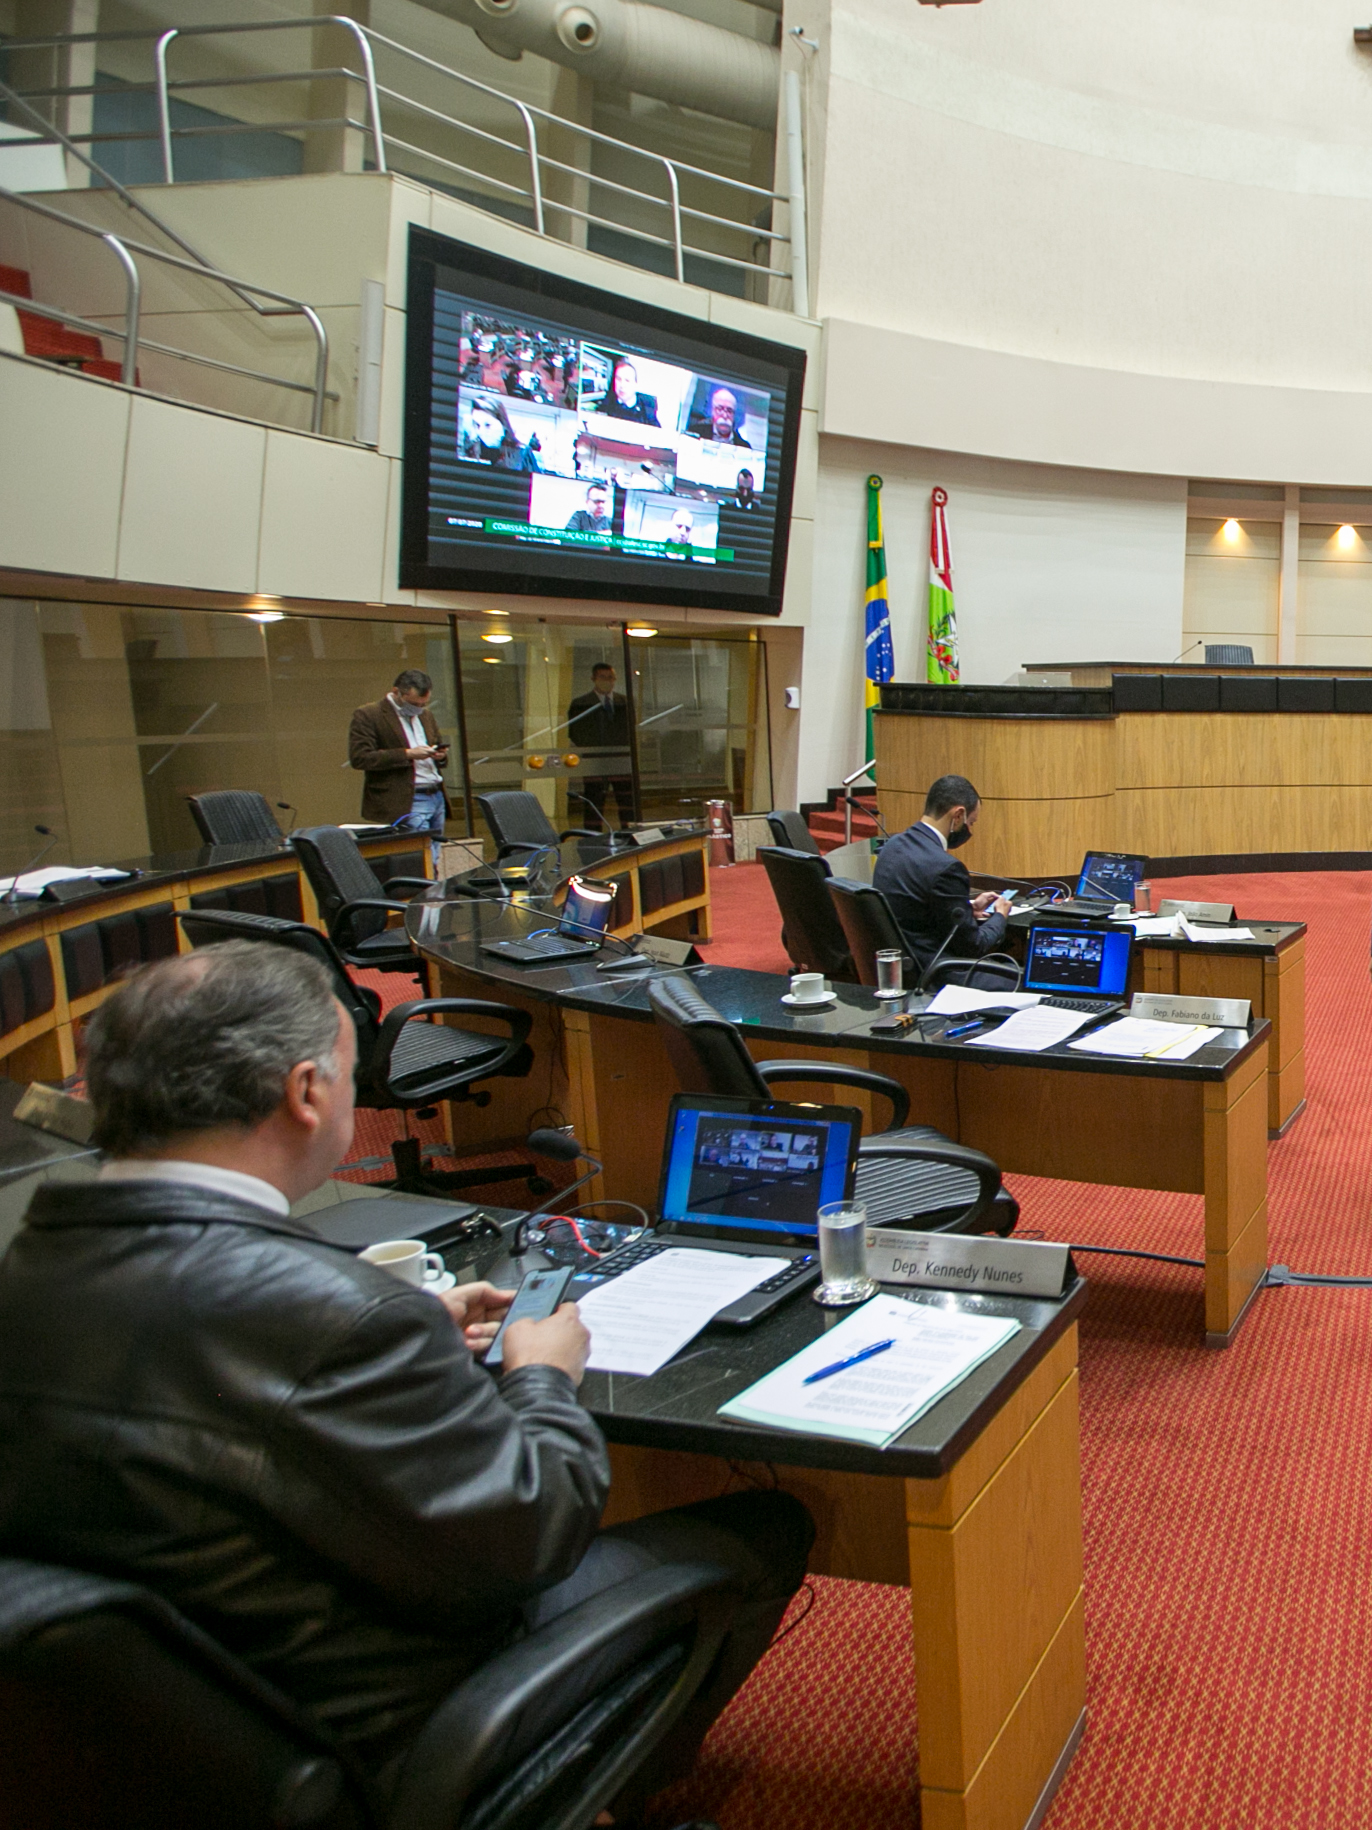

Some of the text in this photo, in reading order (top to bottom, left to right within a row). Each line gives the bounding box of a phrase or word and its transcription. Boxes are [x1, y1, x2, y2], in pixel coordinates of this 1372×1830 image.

[492, 520, 528, 534] COMISSÃO
[528, 526, 538, 535] DE
[538, 527, 584, 542] CONSTITUIÇÃO
[590, 534, 614, 544] JUSTIÇA
[1153, 1008, 1168, 1018] Dep.
[1171, 1010, 1199, 1020] Fabiano
[892, 1258, 1023, 1284] Dep. Kennedy Nunes
